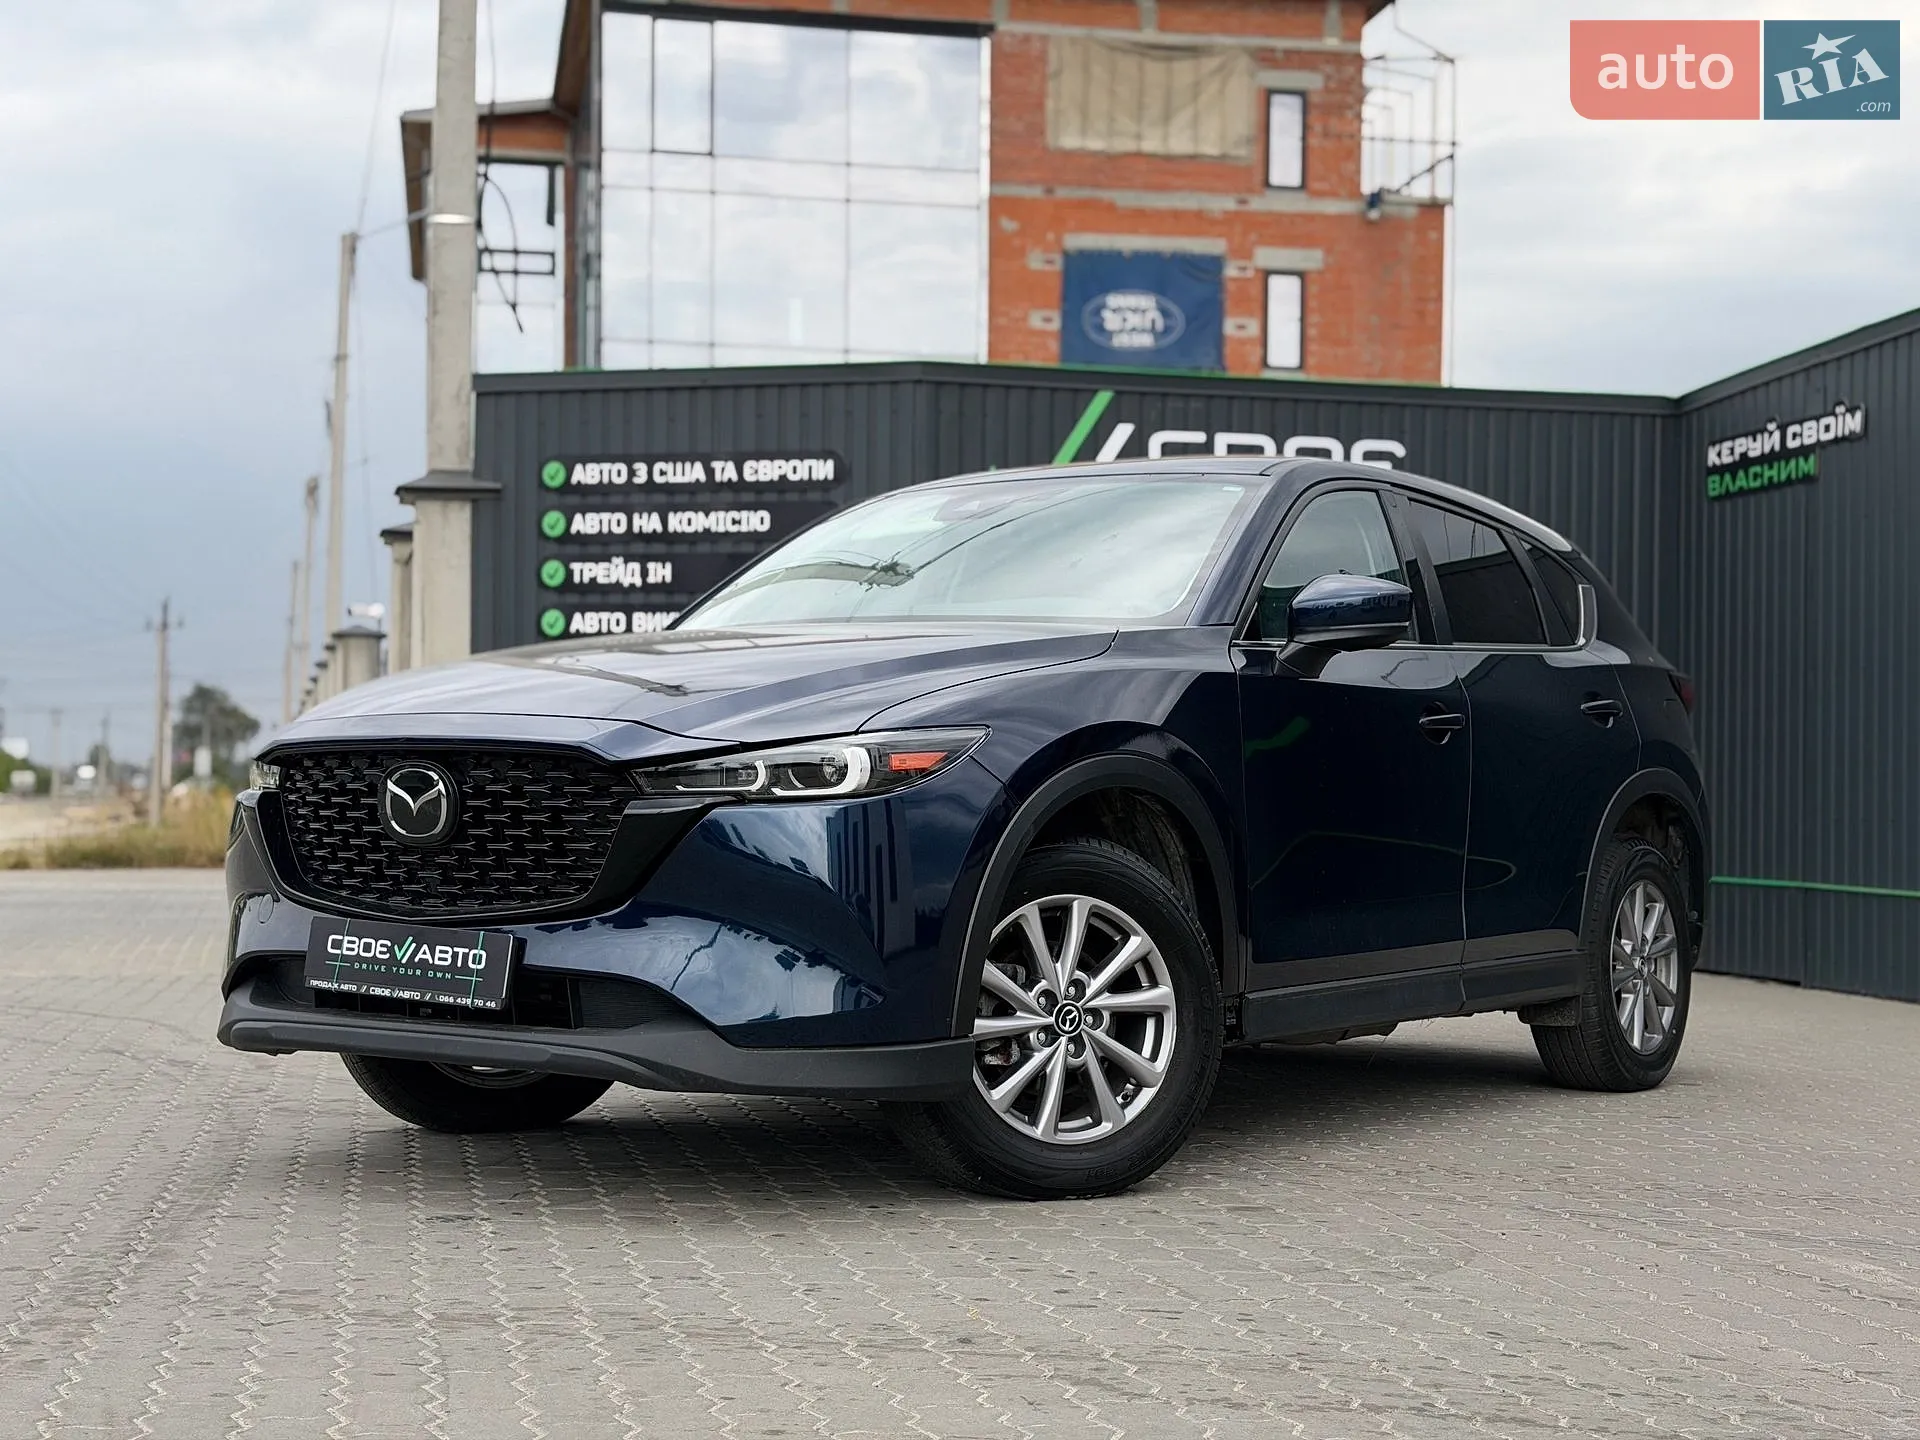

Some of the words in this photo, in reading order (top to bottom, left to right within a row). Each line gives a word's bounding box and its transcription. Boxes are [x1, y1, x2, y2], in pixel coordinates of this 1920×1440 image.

[1707, 421, 1781, 467] КЕРУЙ
[1786, 404, 1862, 449] СВОЇМ
[570, 462, 628, 485] АВТО
[652, 460, 706, 484] США
[711, 459, 738, 482] ТА
[743, 458, 835, 482] ЄВРОПИ
[1707, 454, 1816, 497] ВЛАСНИМ
[570, 512, 627, 534] АВТО
[632, 512, 663, 534] НА
[668, 510, 771, 533] КОМІСІЮ
[569, 556, 643, 587] ТРЕЙД
[646, 562, 672, 583] ІН
[569, 611, 627, 634] АВТО
[327, 934, 392, 960] СВОЄ
[414, 944, 487, 970] АВТО
[354, 962, 387, 973] DRIVE
[392, 966, 422, 977] YOUR
[428, 970, 452, 980] OWN
[310, 979, 339, 991] ПРОДАЖ
[340, 983, 357, 992] АВТО
